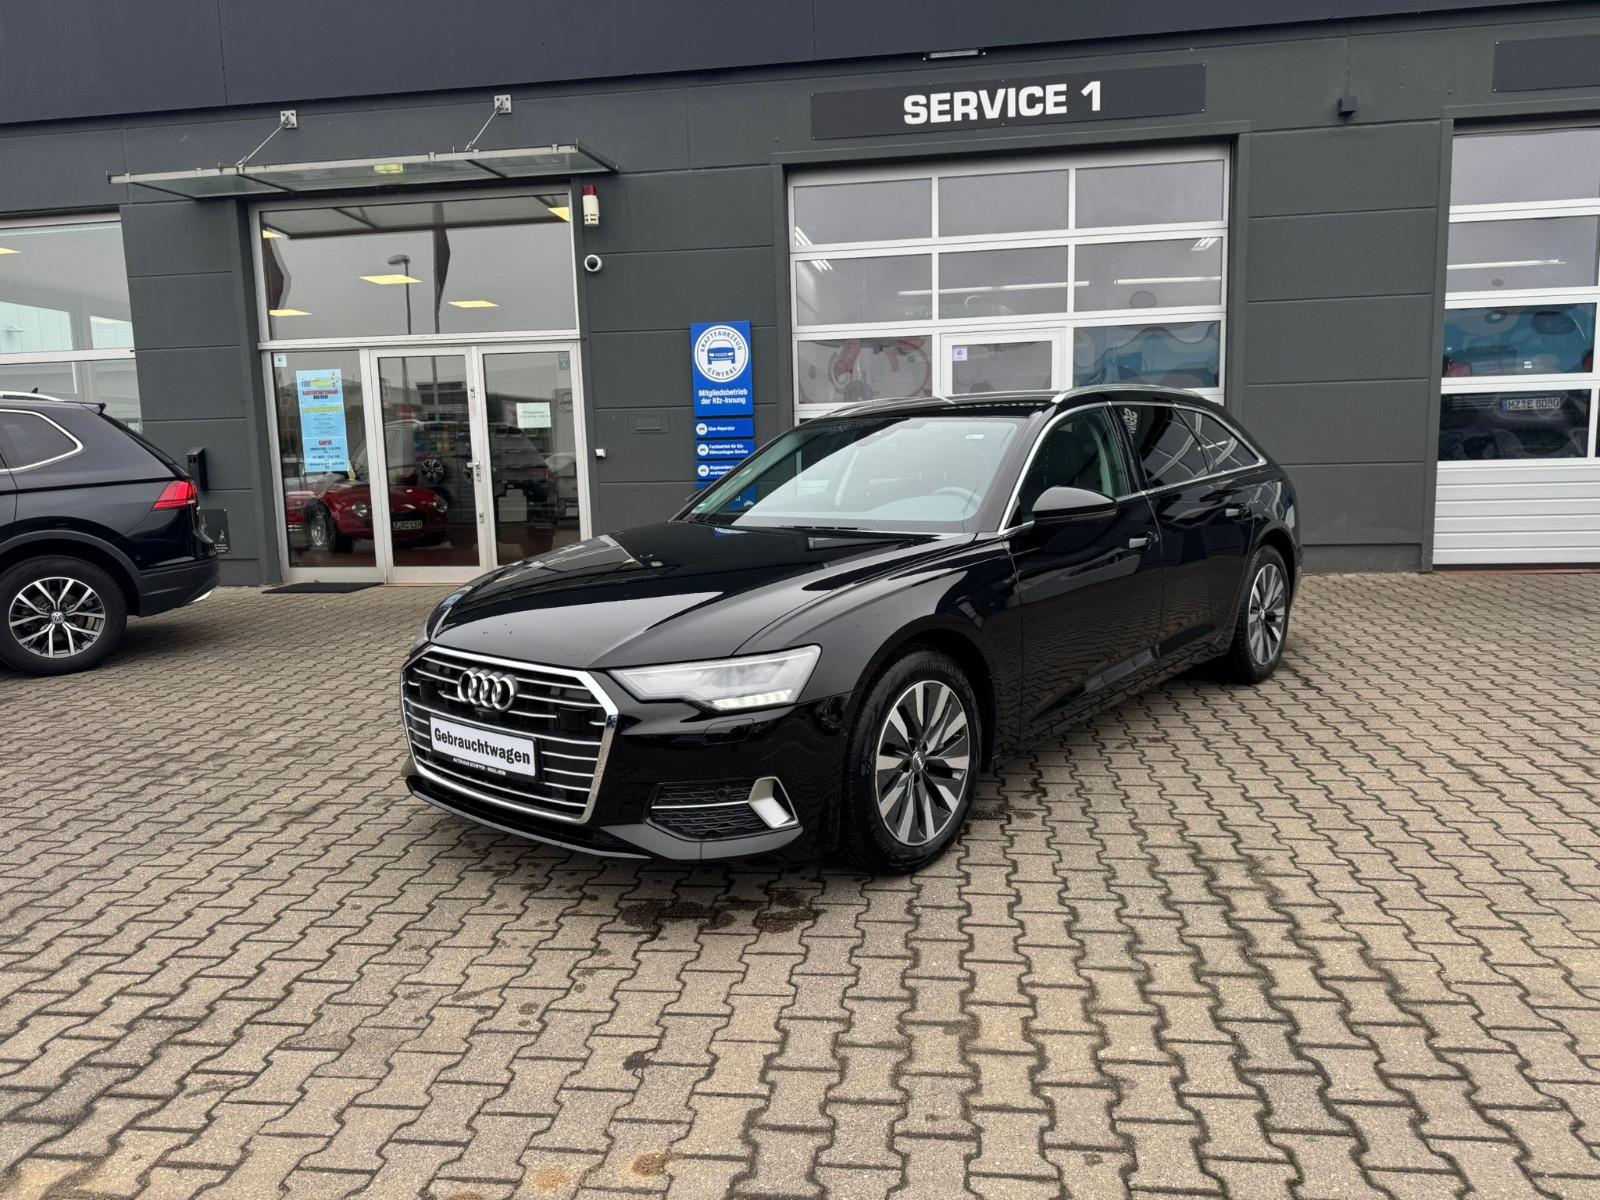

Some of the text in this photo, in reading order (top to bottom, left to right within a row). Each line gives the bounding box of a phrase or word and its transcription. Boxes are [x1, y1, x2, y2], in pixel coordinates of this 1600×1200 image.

[903, 80, 1101, 125] SERVICE 1
[700, 330, 743, 352] KRAFTFAHRZEUG
[707, 366, 738, 377] GEWERBE
[698, 388, 748, 398] Mitgliedsbetrieb
[701, 396, 746, 405] der Kfz-Innung
[434, 727, 531, 765] Gebrauchtwagen
